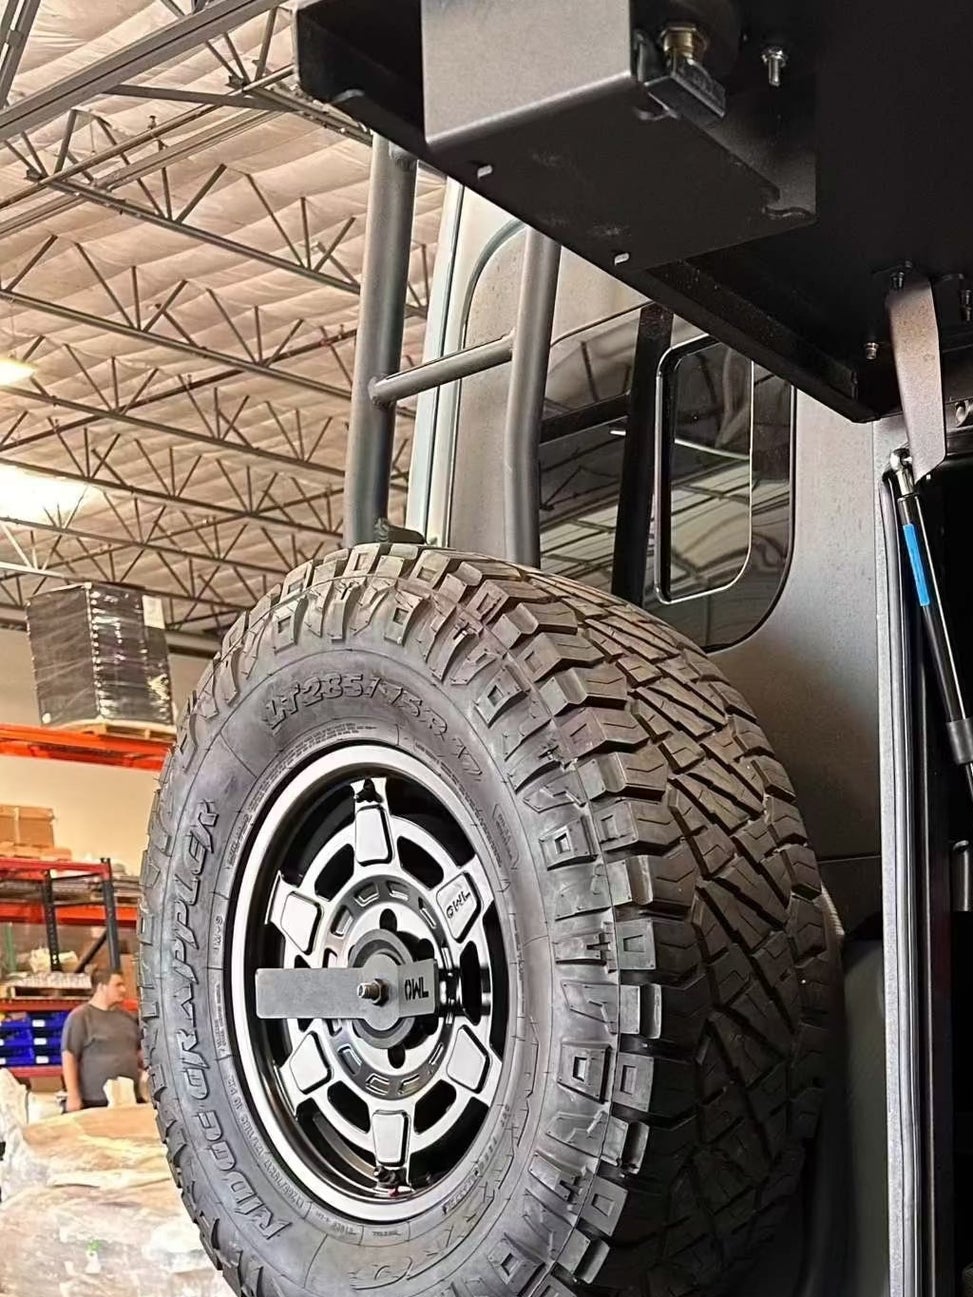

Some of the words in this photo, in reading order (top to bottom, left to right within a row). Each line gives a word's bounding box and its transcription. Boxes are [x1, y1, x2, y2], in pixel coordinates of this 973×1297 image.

[446, 891, 472, 919] OWL
[172, 799, 219, 1101] GRAPPLER
[404, 976, 429, 1001] OWL
